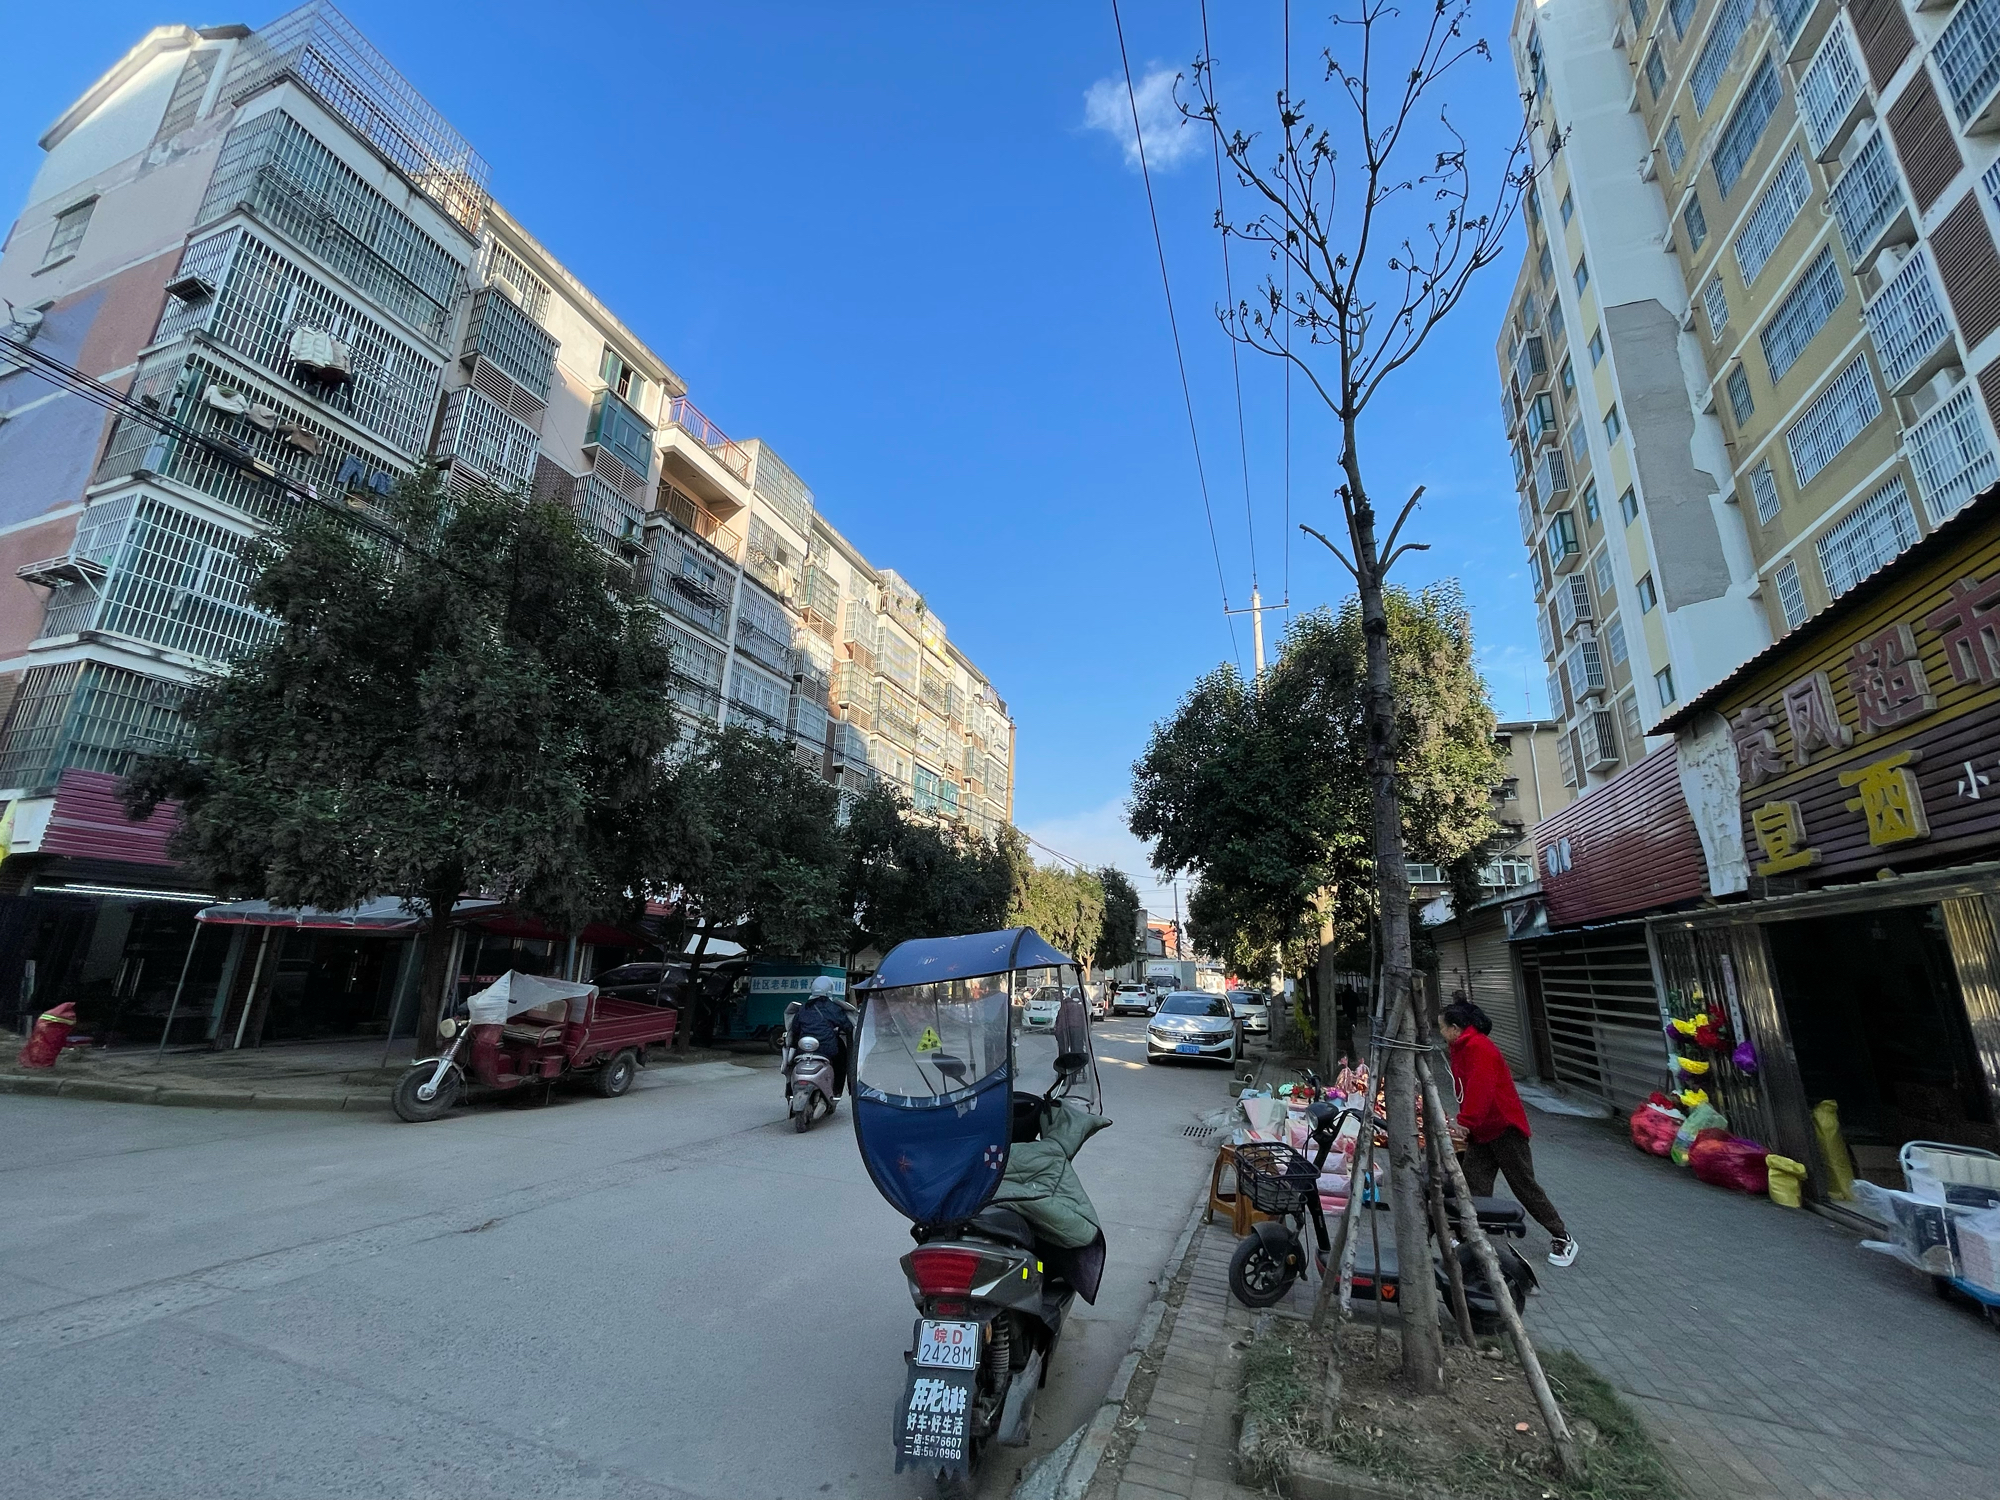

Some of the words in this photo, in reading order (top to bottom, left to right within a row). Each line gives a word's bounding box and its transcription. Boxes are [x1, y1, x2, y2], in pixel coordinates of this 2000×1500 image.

[753, 979, 814, 990] 社区老年助餐
[922, 1344, 972, 1365] 2428M
